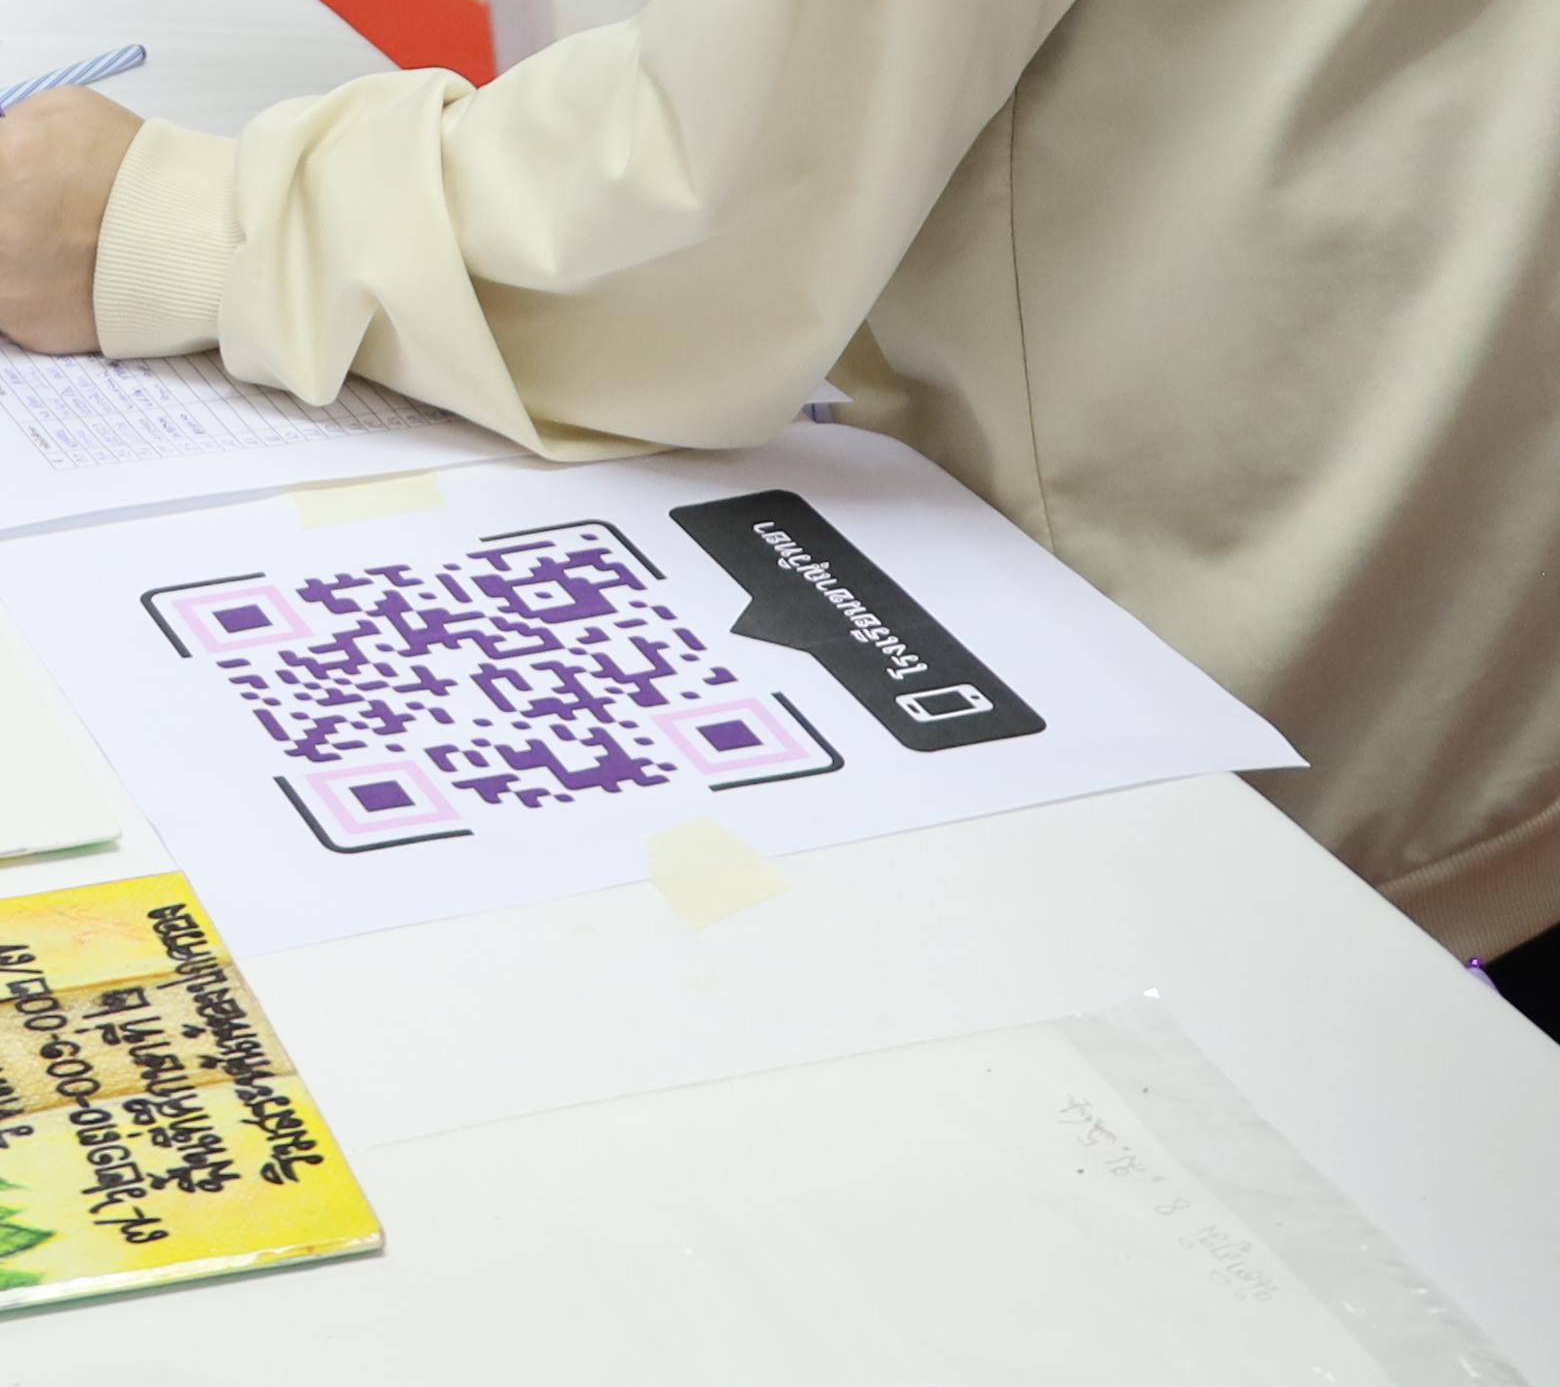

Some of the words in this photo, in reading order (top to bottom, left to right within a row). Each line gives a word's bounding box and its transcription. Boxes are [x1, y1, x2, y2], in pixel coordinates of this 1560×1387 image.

[750, 518, 931, 683] โรงเรียนขาณุวิทยา
[78, 985, 160, 1020] ๒
[91, 1022, 242, 1195] พื้นที่ศึกษาที่
